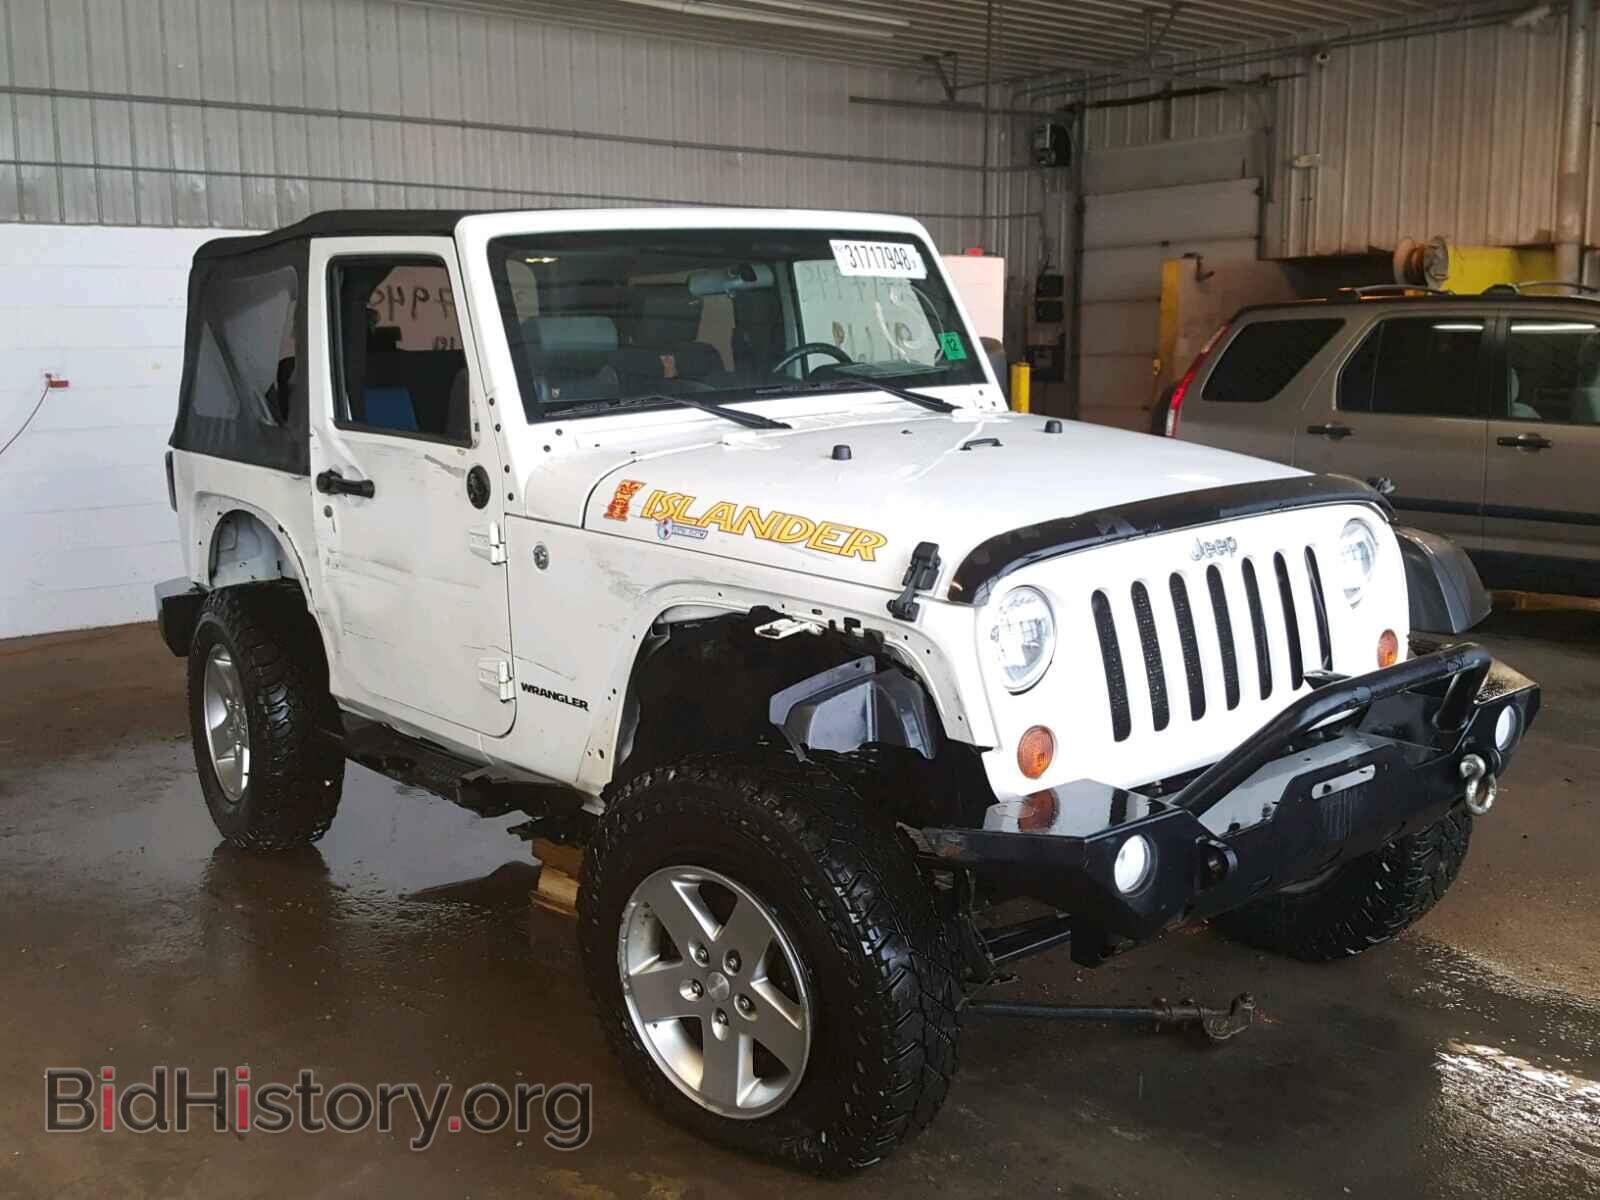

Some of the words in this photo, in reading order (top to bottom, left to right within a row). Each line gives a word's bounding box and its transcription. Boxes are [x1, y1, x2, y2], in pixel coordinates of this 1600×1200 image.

[844, 244, 912, 271] 31717948
[640, 489, 888, 562] ISLANDER
[1191, 536, 1238, 561] Jeep
[521, 682, 590, 712] WRANGLER
